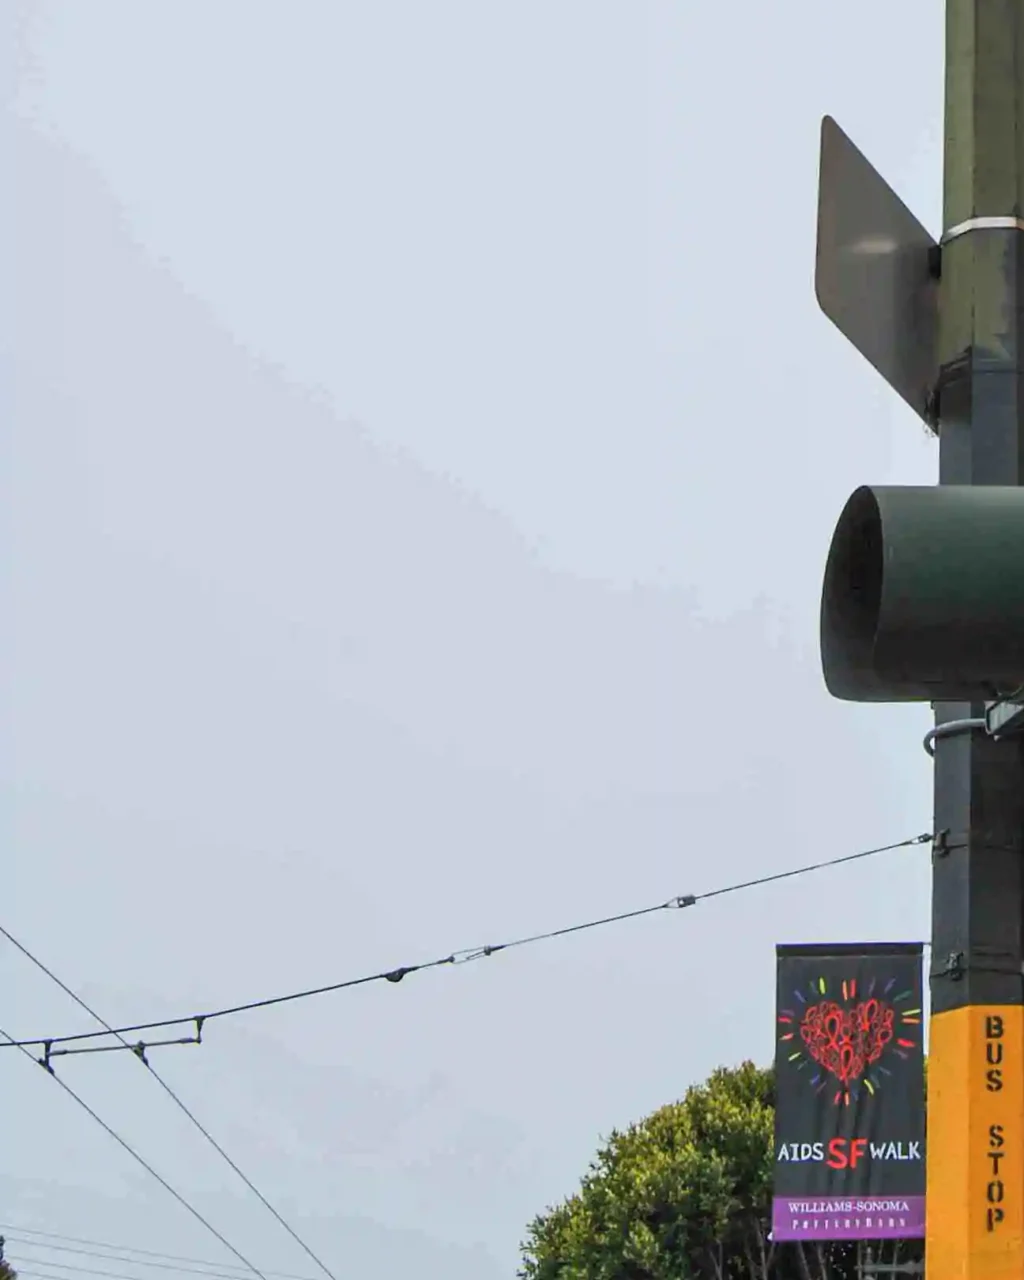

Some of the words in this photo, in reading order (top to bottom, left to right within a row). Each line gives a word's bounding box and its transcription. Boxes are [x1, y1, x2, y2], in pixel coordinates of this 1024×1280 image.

[984, 1015, 1004, 1092] BUS
[777, 1142, 824, 1161] AIDS
[826, 1137, 868, 1169] SF
[870, 1141, 921, 1160] WALK
[986, 1124, 1005, 1232] STOP
[788, 1201, 910, 1214] WILLIAMS-SONOMA
